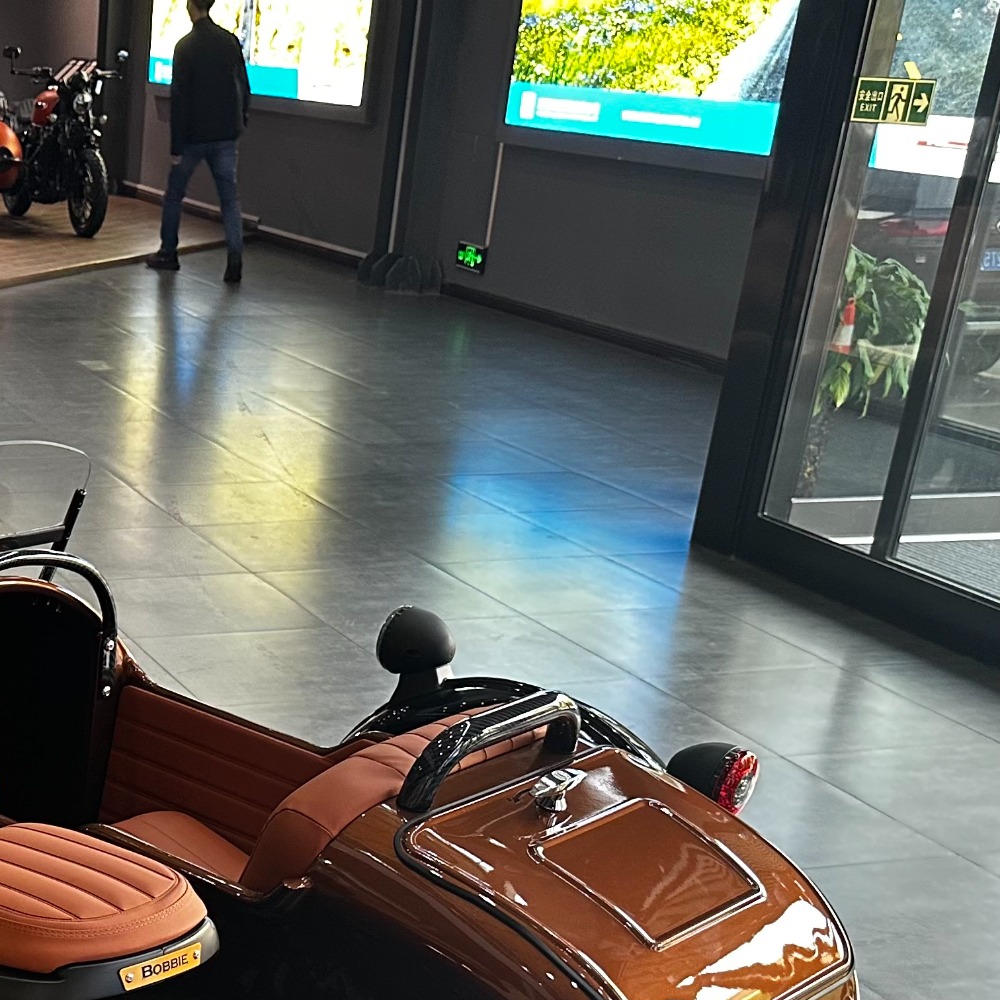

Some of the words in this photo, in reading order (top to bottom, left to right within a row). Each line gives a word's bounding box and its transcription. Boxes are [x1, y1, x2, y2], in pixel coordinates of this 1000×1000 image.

[858, 89, 884, 101] 安全出口
[859, 103, 877, 112] EXIT
[141, 954, 188, 979] BOBBIE
